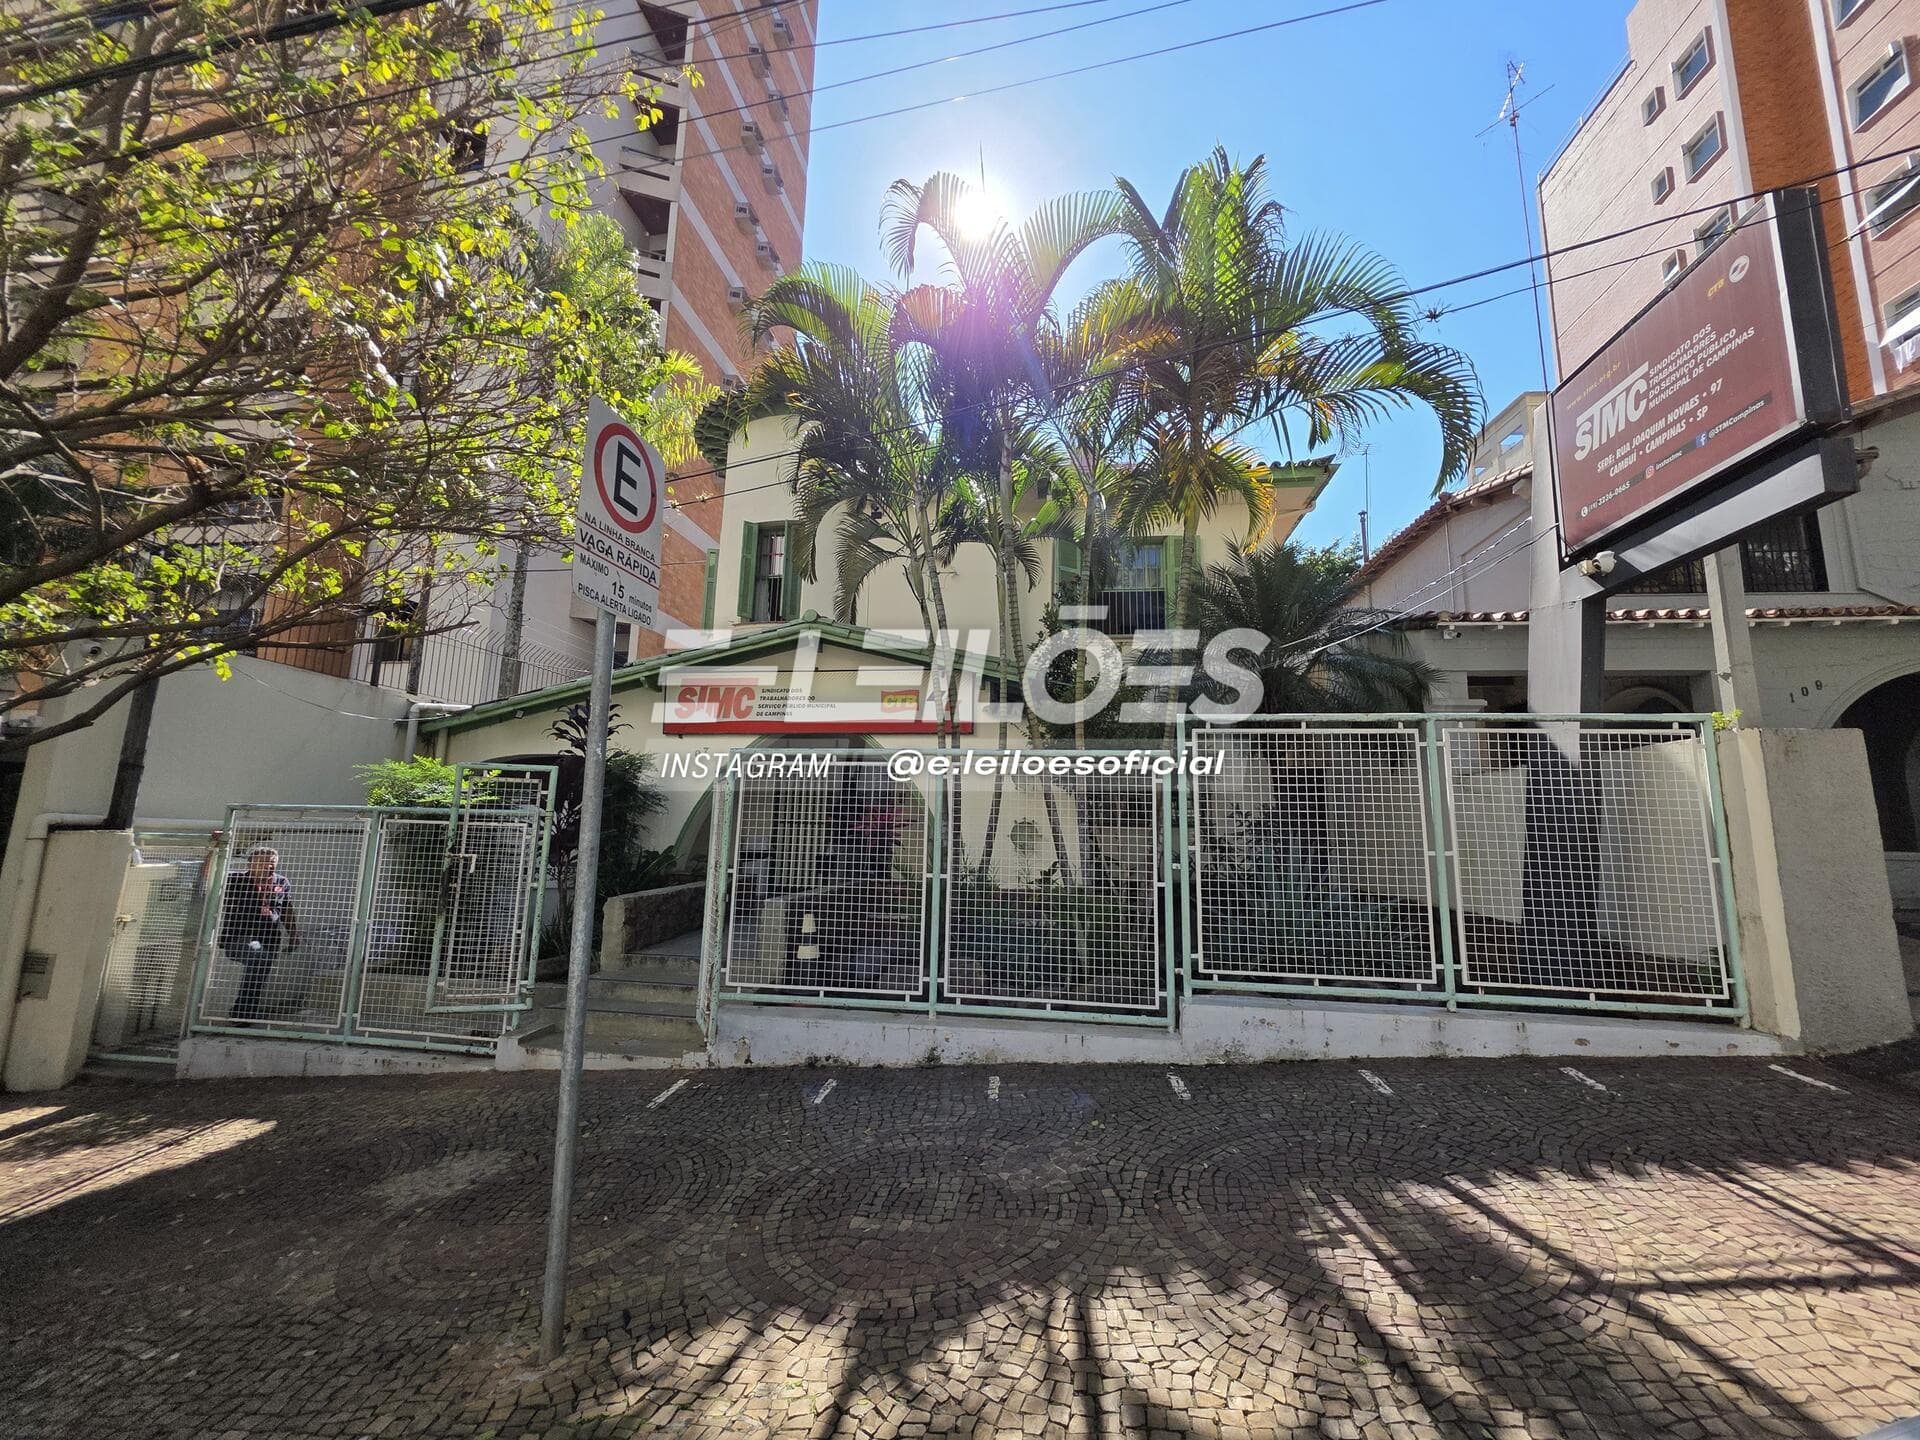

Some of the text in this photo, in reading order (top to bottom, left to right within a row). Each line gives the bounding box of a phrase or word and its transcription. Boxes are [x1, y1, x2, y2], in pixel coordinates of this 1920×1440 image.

[1649, 323, 1712, 378] SINDICATO DOS
[1649, 331, 1717, 388] TRABALHADORES
[1649, 327, 1755, 410] MUNICIPAL DE CAMPINAS
[1649, 388, 1660, 399] DO
[1660, 359, 1695, 390] SERVIÇO
[1574, 361, 1649, 461] STMC
[1597, 378, 1723, 473] SEDE: RUA JOAQUIM NOVAES 97
[1645, 419, 1686, 453] CAMPINAS
[1696, 405, 1708, 421] SP
[613, 440, 641, 517] E
[580, 528, 657, 583] VAGA RÁPIDA
[585, 512, 656, 562] NA LINHA BRANCA
[578, 583, 652, 625] PISCA ALERTA LIGADO
[612, 581, 652, 613] 15 minutos
[674, 677, 759, 720] STMC
[1790, 680, 1823, 703] 109
